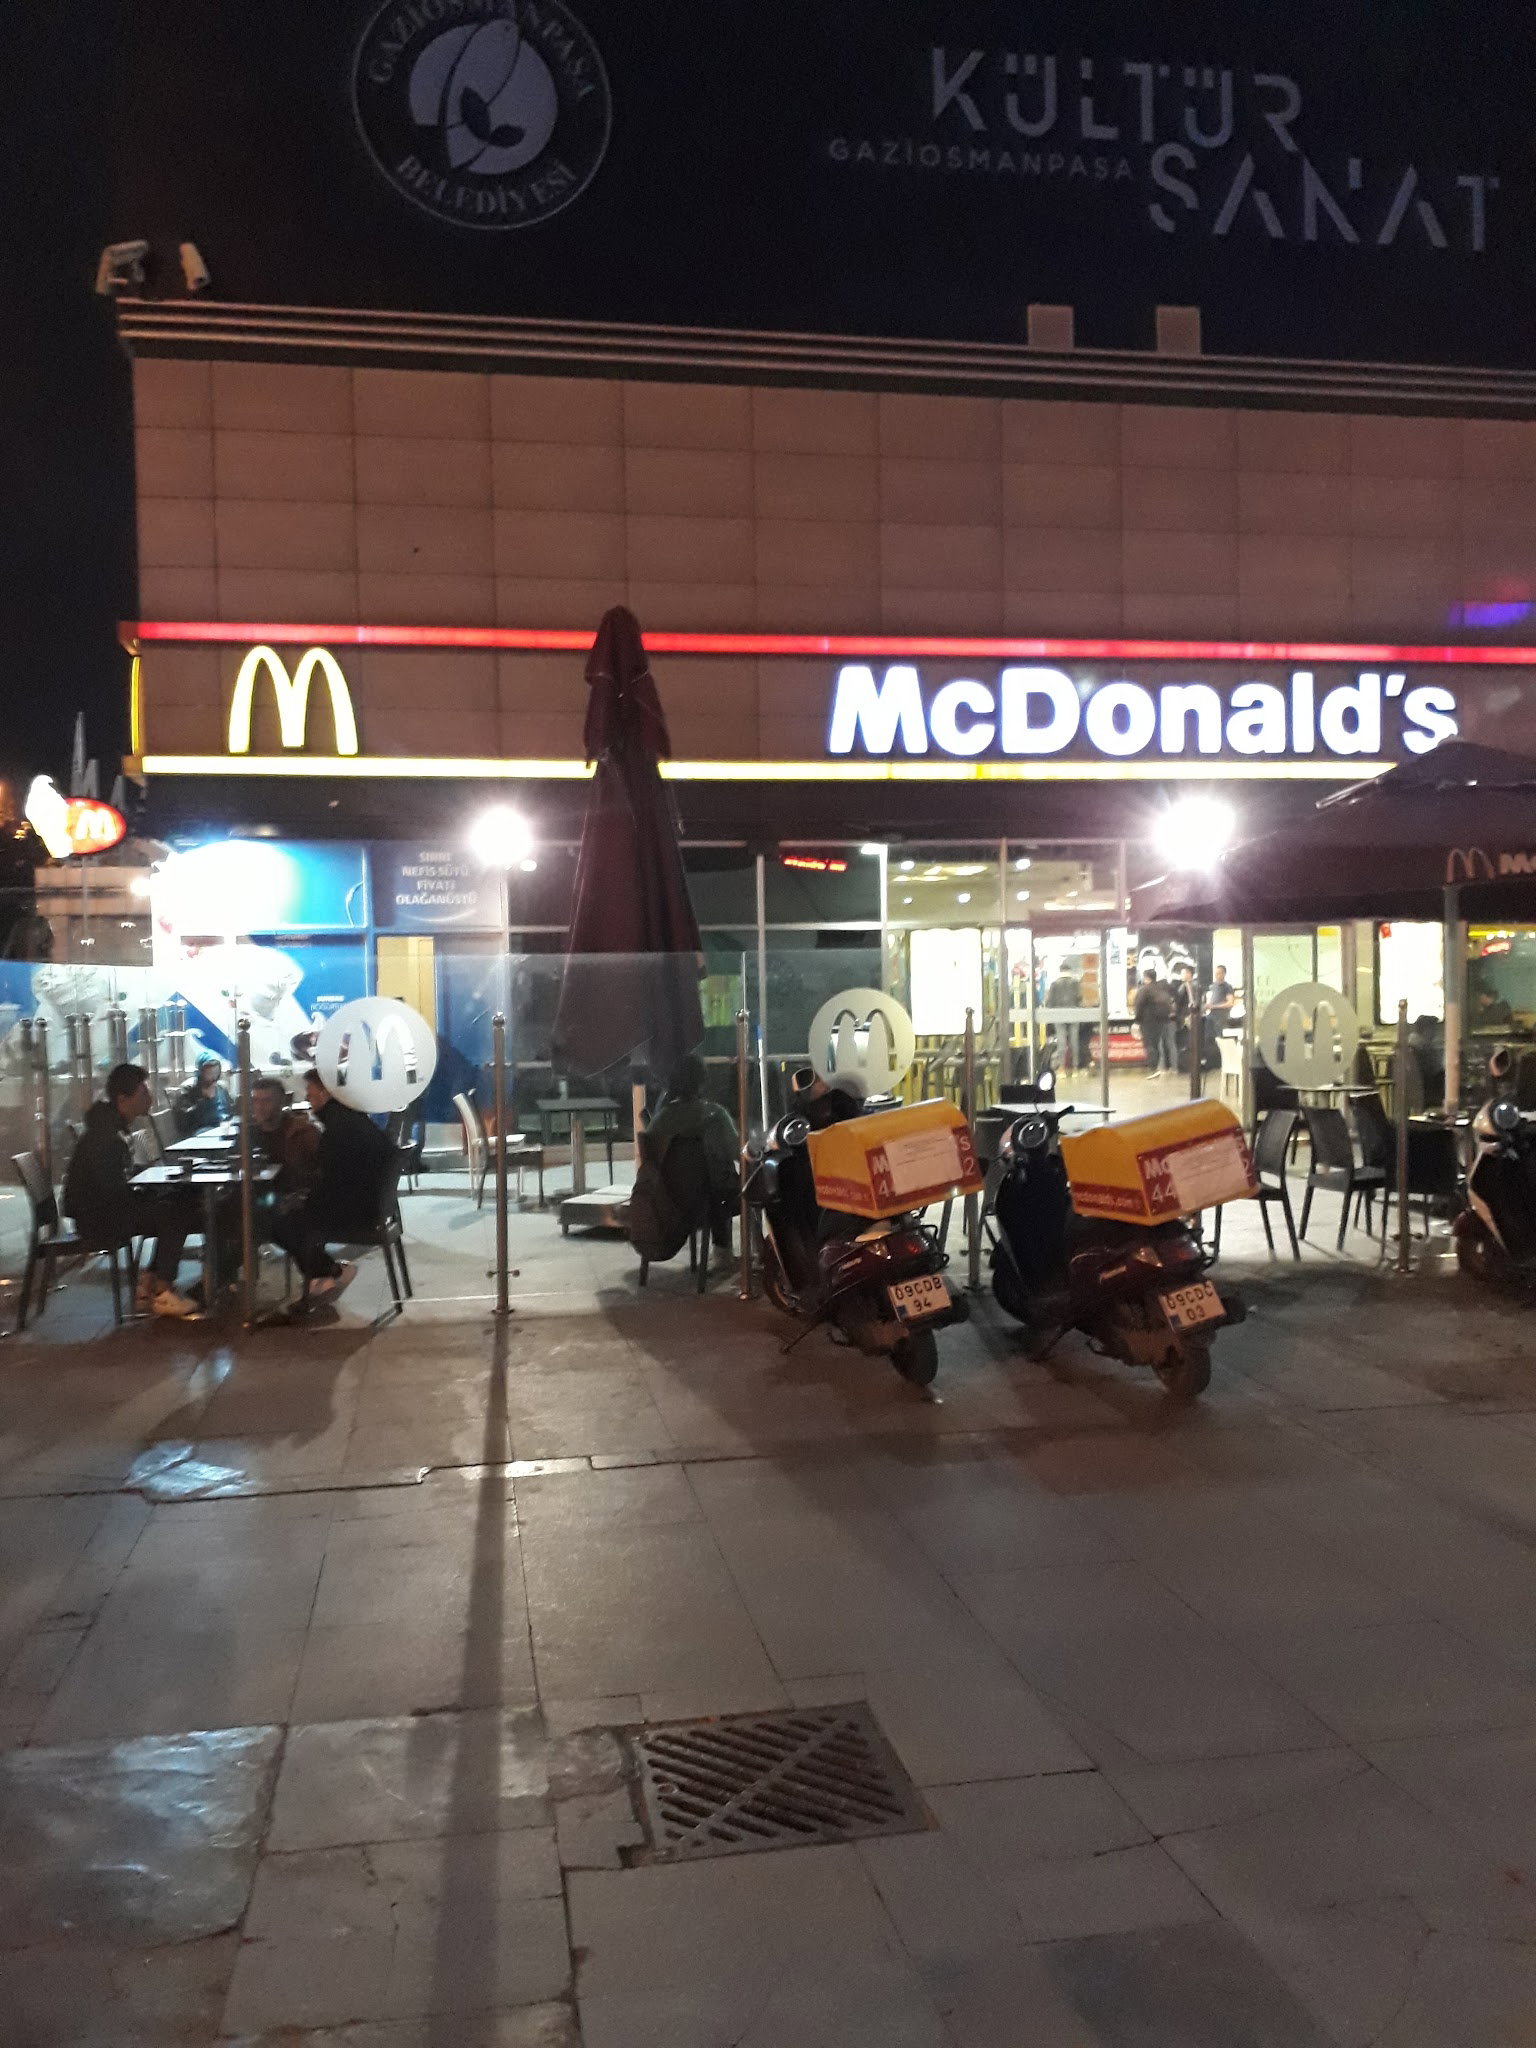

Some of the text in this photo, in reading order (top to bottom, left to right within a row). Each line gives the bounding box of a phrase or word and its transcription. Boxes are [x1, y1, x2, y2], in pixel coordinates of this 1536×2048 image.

[931, 46, 1301, 152] KÜLTÜR
[1148, 142, 1499, 252] SANAT
[828, 665, 1458, 756] McDonald's
[913, 1297, 931, 1312] 94
[1186, 1305, 1205, 1320] 03
